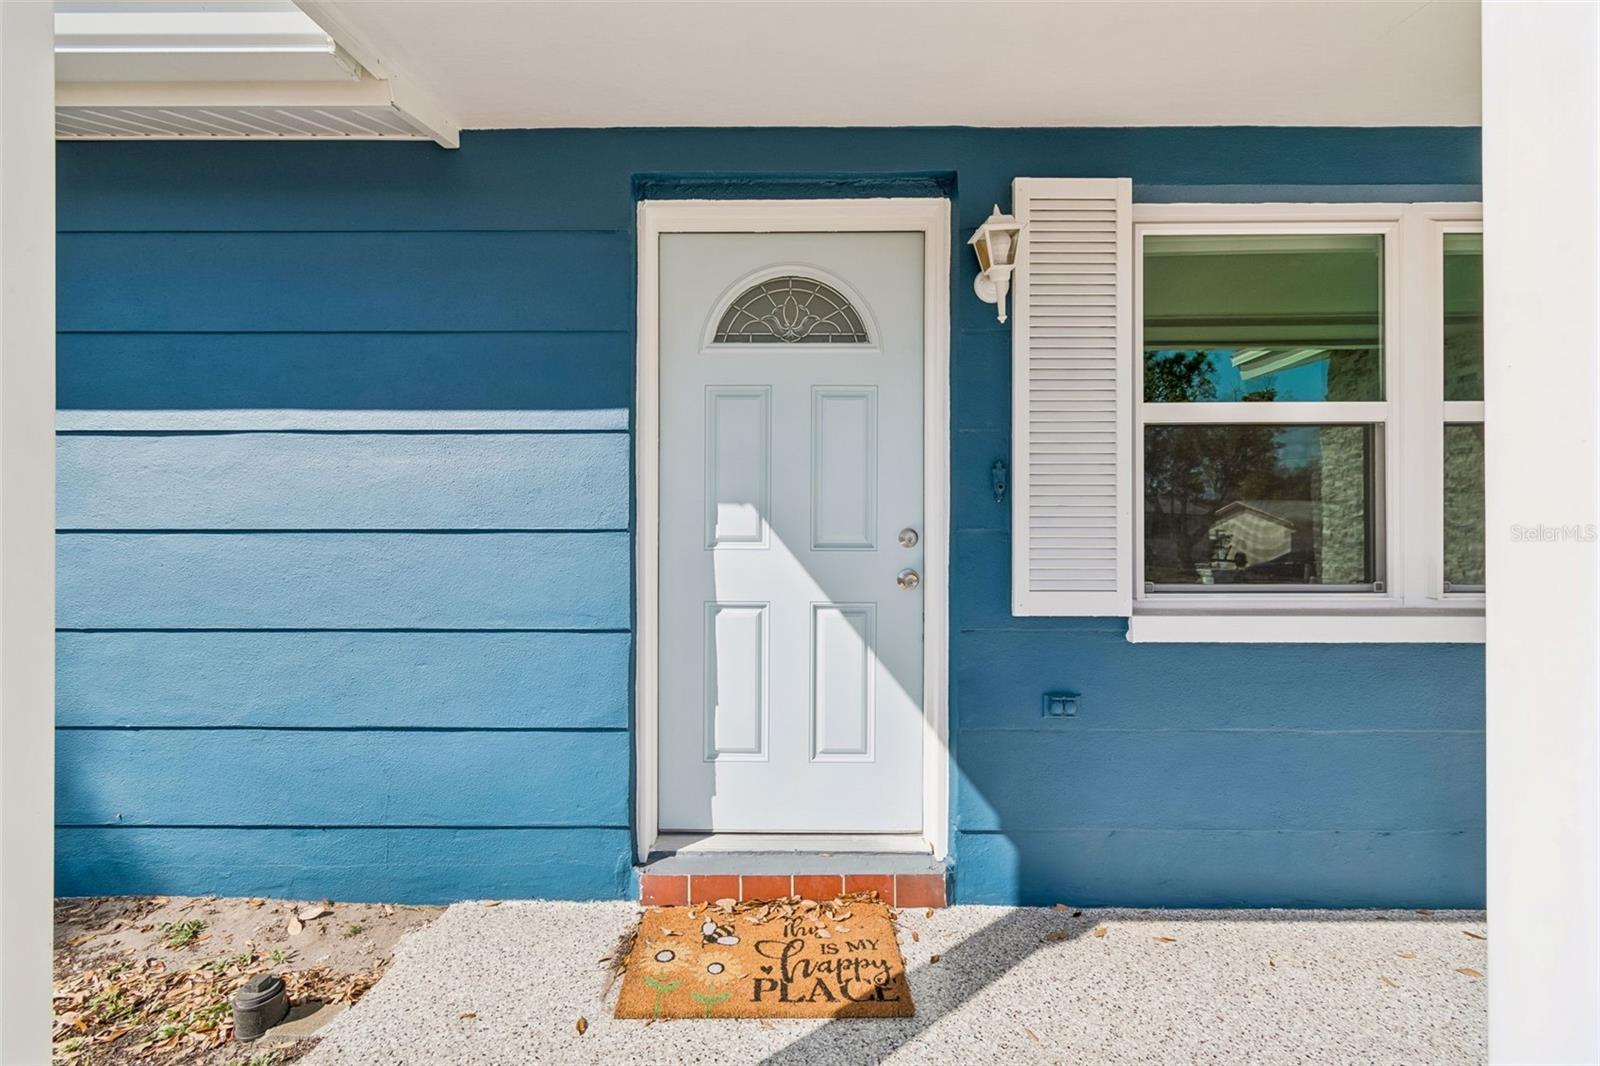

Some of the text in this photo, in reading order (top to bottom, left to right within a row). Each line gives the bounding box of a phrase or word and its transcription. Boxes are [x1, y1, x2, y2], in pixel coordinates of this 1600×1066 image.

[820, 939, 879, 955] IS MY
[754, 938, 892, 985] happy
[750, 977, 900, 1003] PLACE
